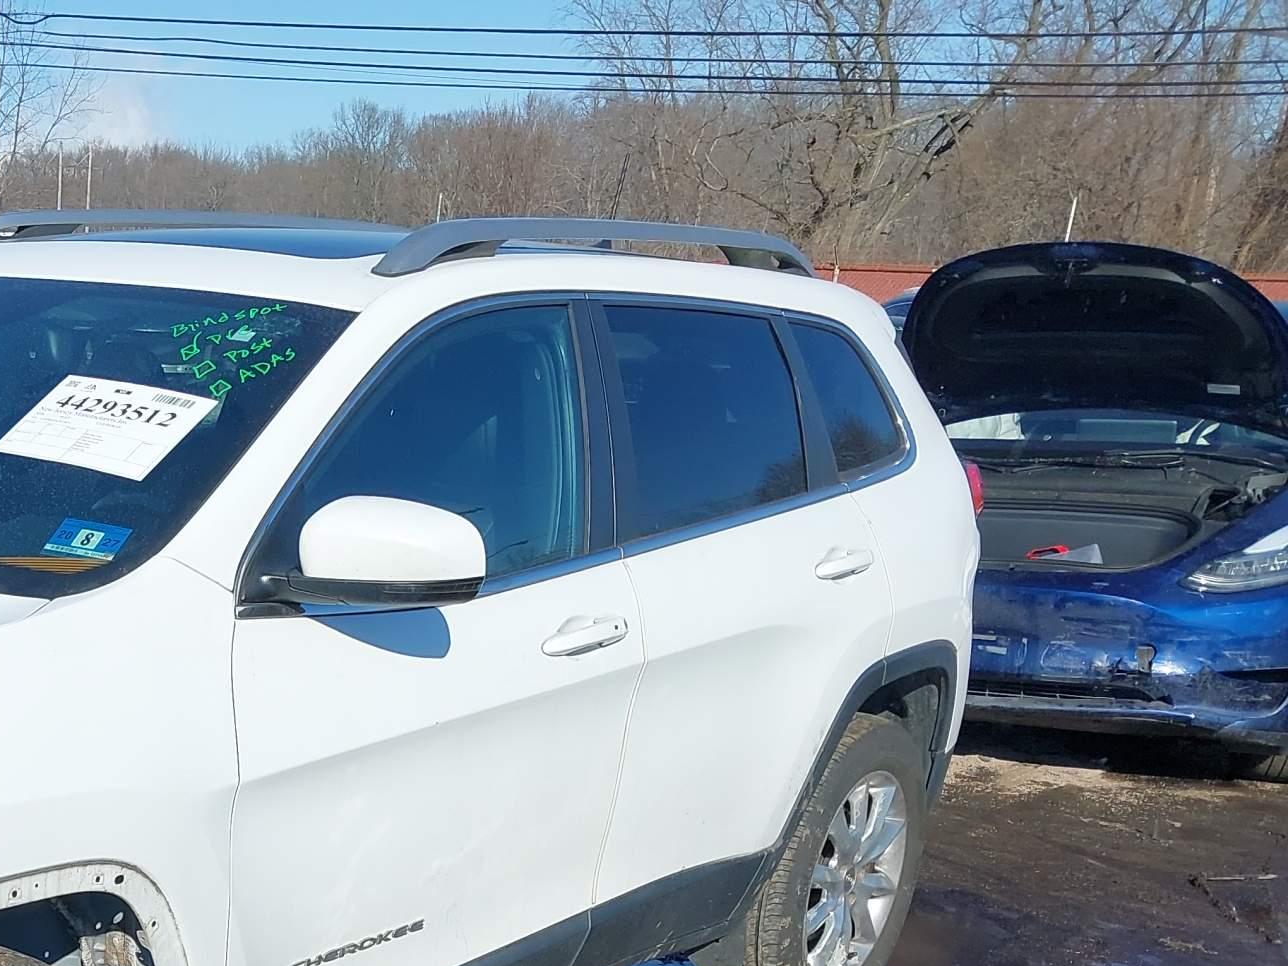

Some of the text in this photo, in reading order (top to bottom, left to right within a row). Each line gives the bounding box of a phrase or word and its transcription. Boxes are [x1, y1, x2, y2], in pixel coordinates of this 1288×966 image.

[239, 348, 296, 383] ADAS
[55, 394, 178, 428] 44293512
[79, 532, 95, 547] 8
